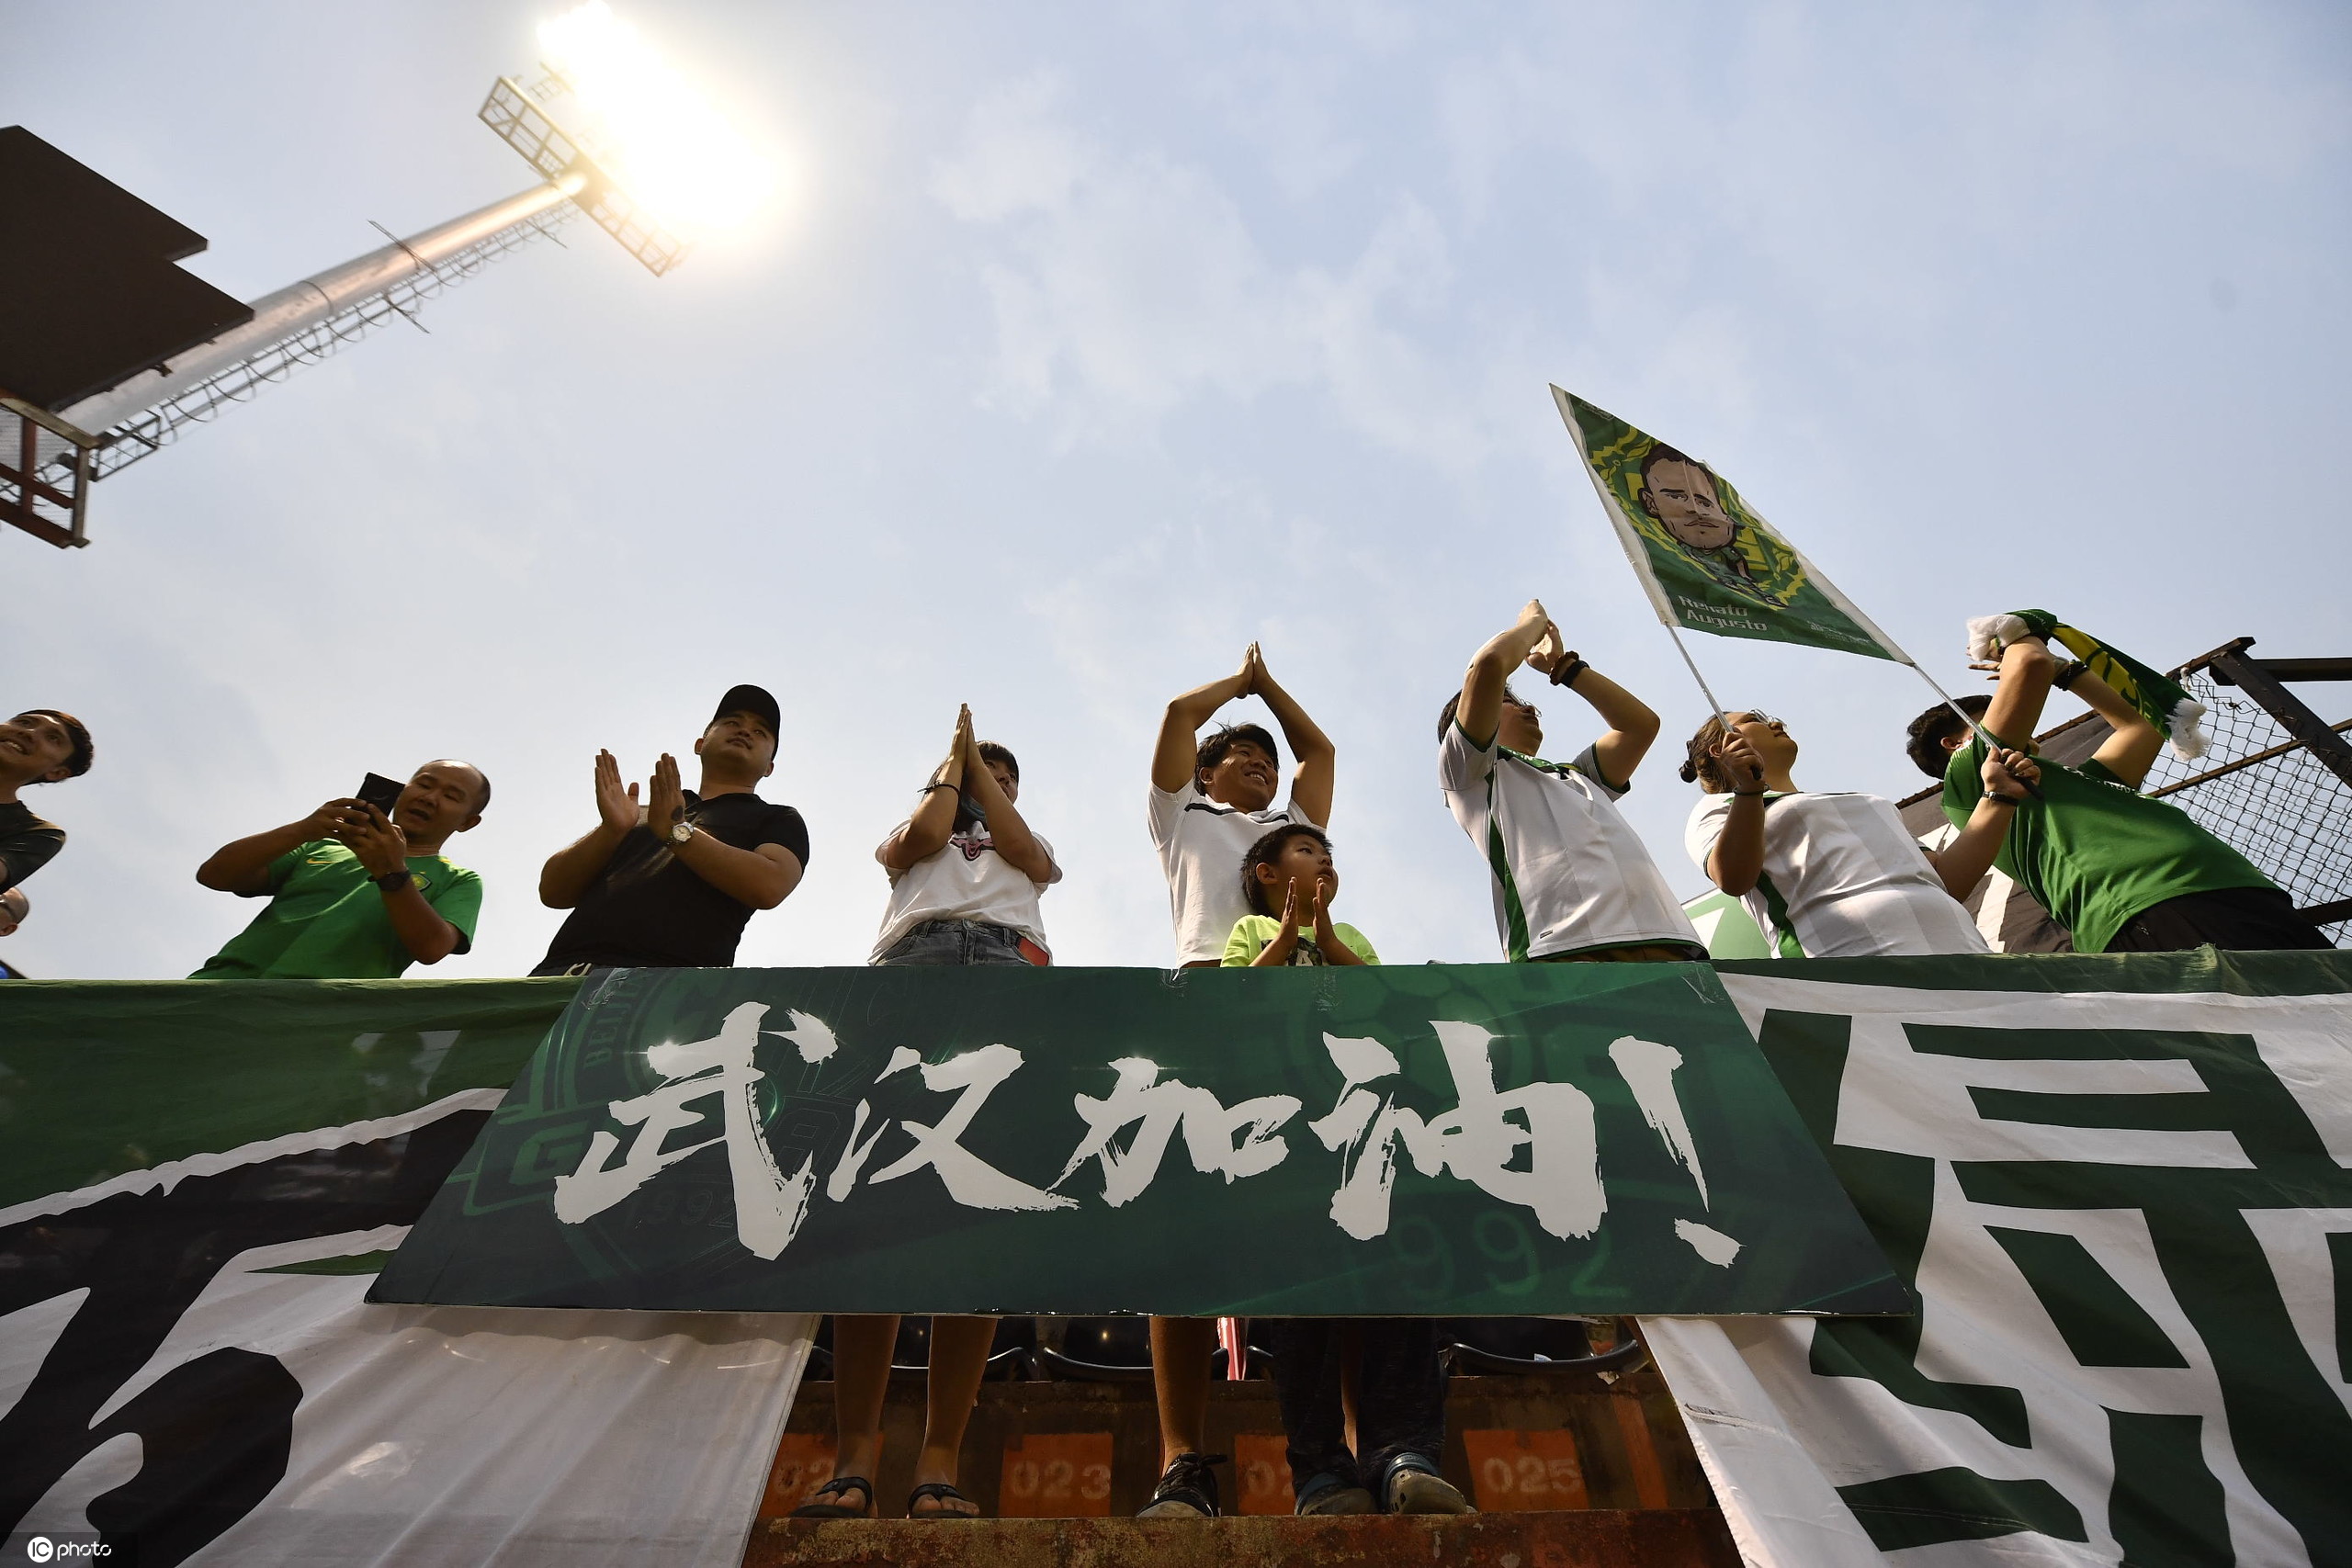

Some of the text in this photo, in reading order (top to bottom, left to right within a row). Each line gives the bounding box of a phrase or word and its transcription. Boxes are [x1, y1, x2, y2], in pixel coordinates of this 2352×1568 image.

[1678, 594, 1748, 617] Renato
[1687, 608, 1769, 631] Augusto
[554, 1001, 1743, 1269] 武汉加油!
[1012, 1460, 1111, 1500] 023
[1484, 1456, 1582, 1495] 025
